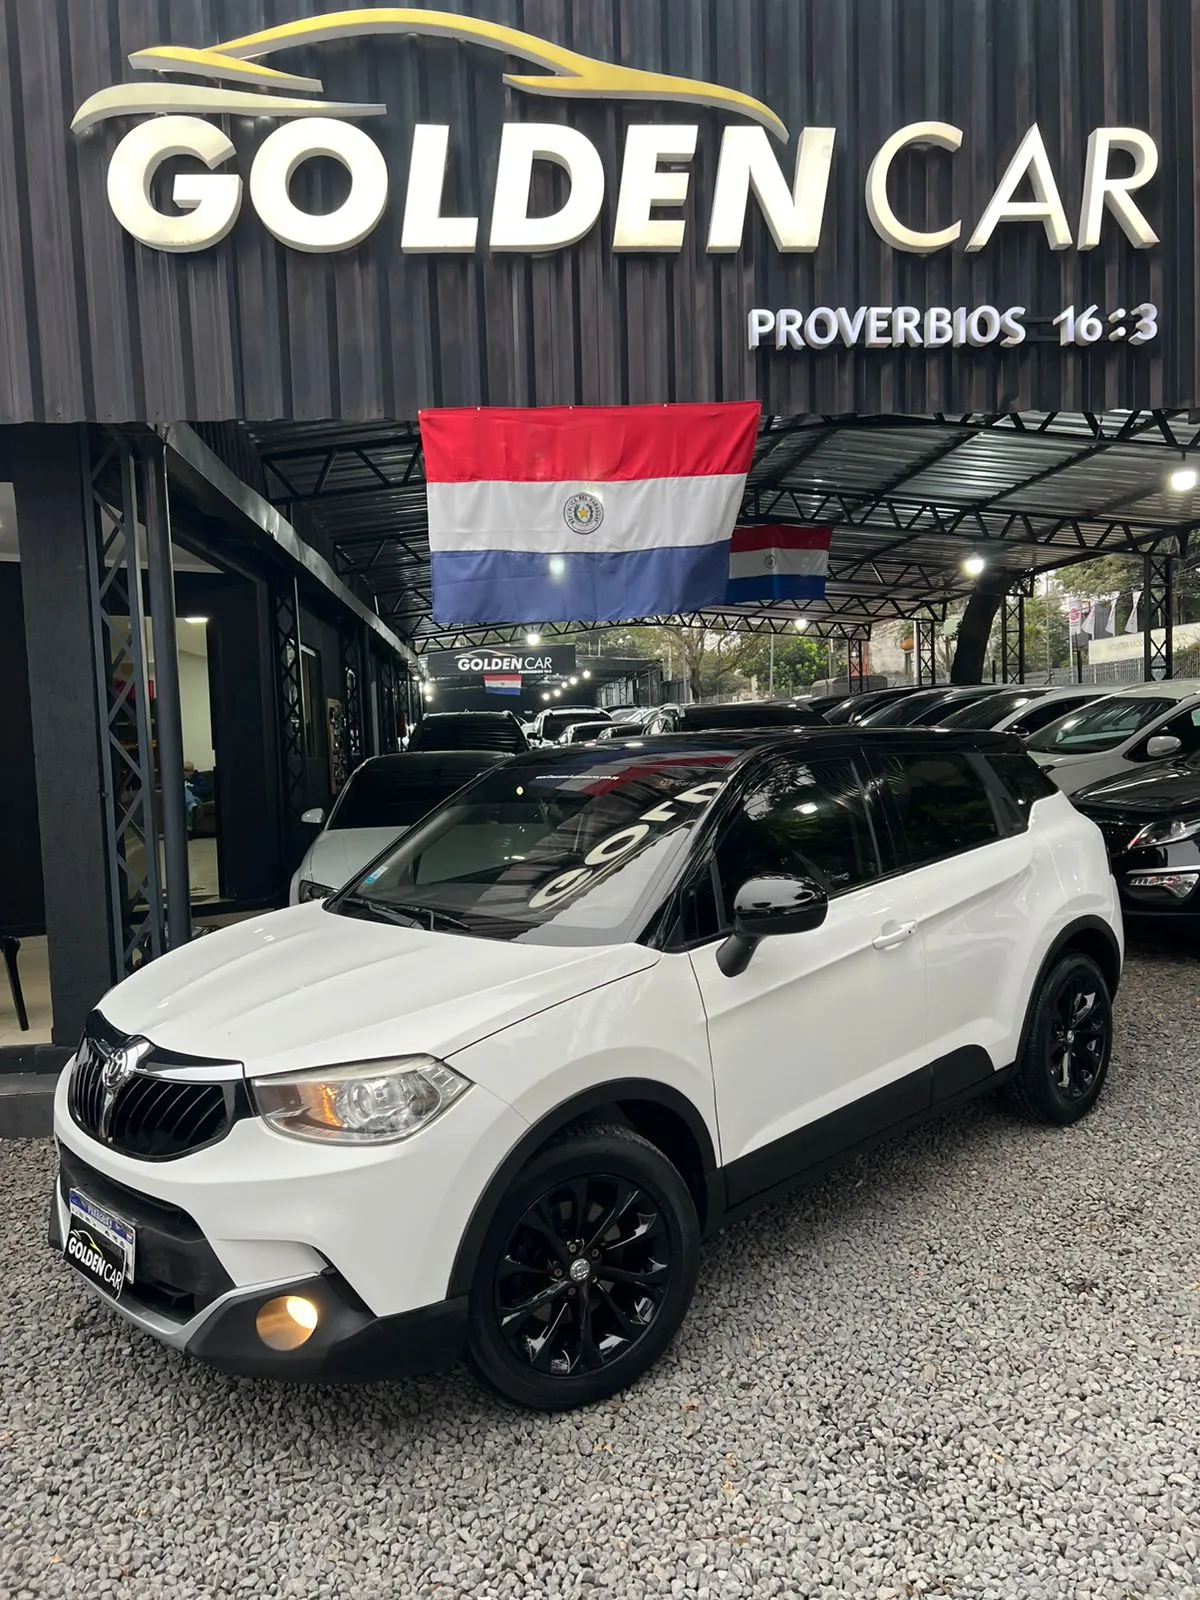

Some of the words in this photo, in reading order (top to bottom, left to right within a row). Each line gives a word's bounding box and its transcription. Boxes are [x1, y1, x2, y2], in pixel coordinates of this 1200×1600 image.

[106, 116, 836, 253] GOLDEN
[864, 121, 1162, 252] CAR
[748, 305, 1027, 351] PROVERBIOS
[1052, 302, 1159, 348] 16:3
[458, 658, 522, 671] GOLDEN
[524, 657, 552, 669] CAR
[69, 1237, 106, 1276] GOLDEN
[104, 1264, 122, 1290] CAR
